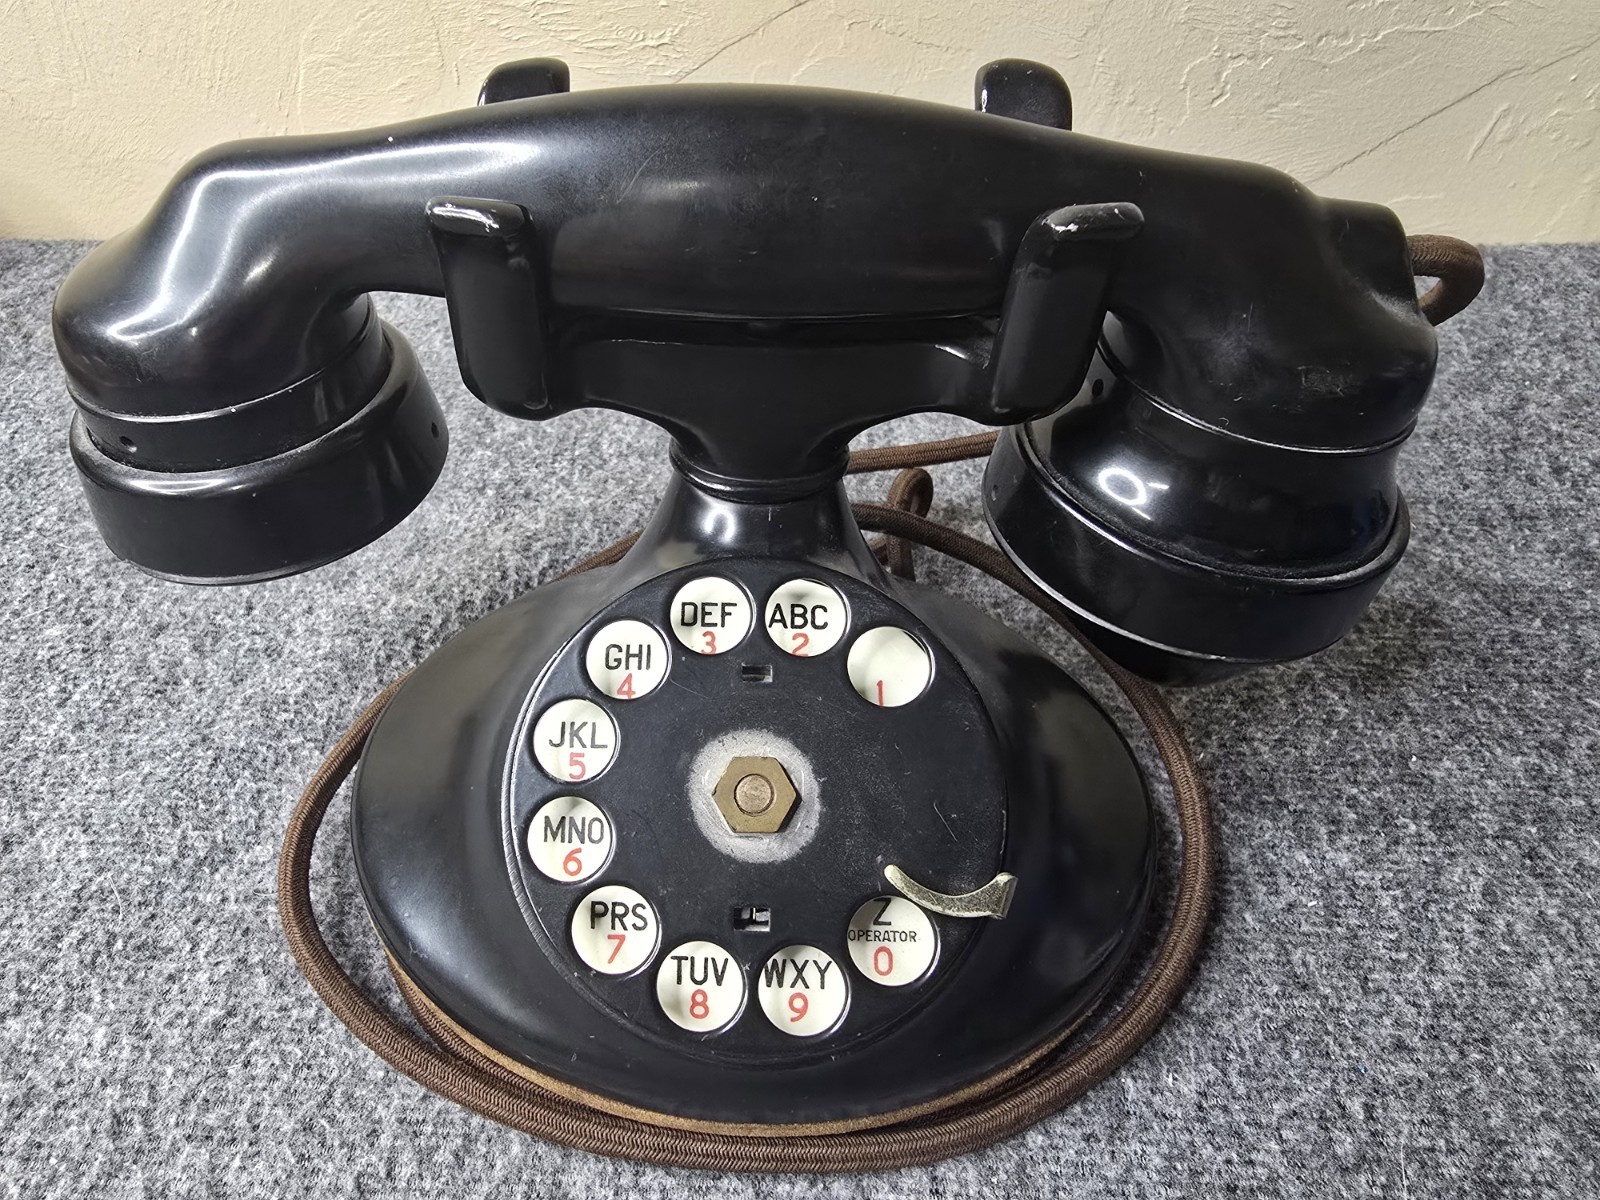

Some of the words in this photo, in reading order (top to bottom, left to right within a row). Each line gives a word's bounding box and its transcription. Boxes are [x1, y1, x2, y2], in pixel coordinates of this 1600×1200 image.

[680, 601, 738, 628] DEF
[767, 602, 829, 630] ABC
[604, 643, 652, 671] GHI
[700, 630, 717, 655] 3
[791, 632, 810, 657] 2
[616, 672, 636, 700] 4
[876, 679, 884, 707] 1
[548, 721, 609, 749] JKL
[568, 751, 587, 780] 5
[543, 815, 605, 845] MNO
[562, 847, 583, 877] 6
[590, 900, 648, 931] PRS
[873, 897, 892, 926] Z
[607, 934, 626, 964] 7
[847, 929, 918, 943] OPERATOR
[670, 955, 729, 987] TUV
[763, 958, 833, 990] WXY
[873, 945, 894, 977] 0
[689, 988, 710, 1020] 8
[788, 992, 809, 1023] 9
